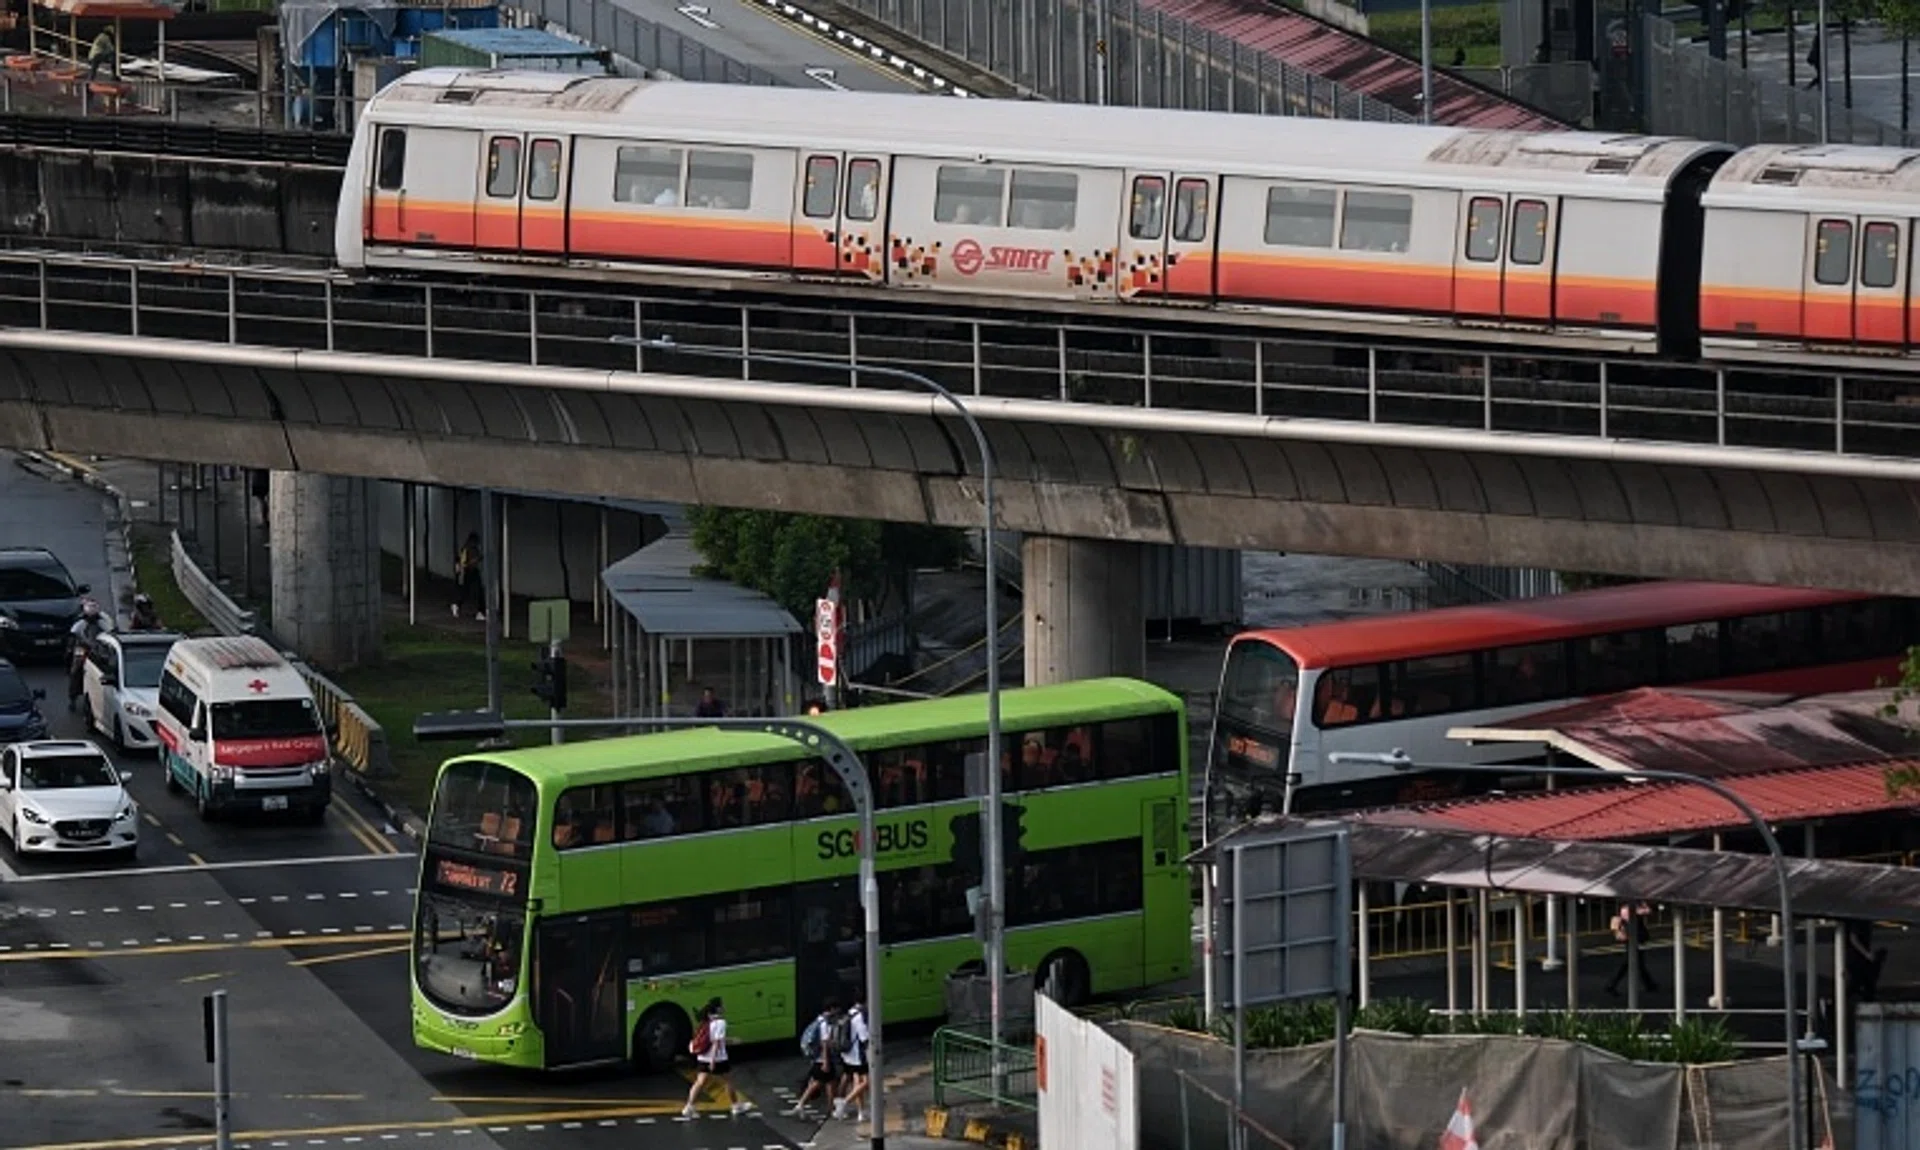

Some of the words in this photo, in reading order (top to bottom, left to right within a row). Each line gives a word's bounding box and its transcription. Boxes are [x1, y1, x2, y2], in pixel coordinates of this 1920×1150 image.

[984, 246, 1055, 271] SMRT
[876, 820, 928, 852] BUS
[500, 870, 518, 895] 72
